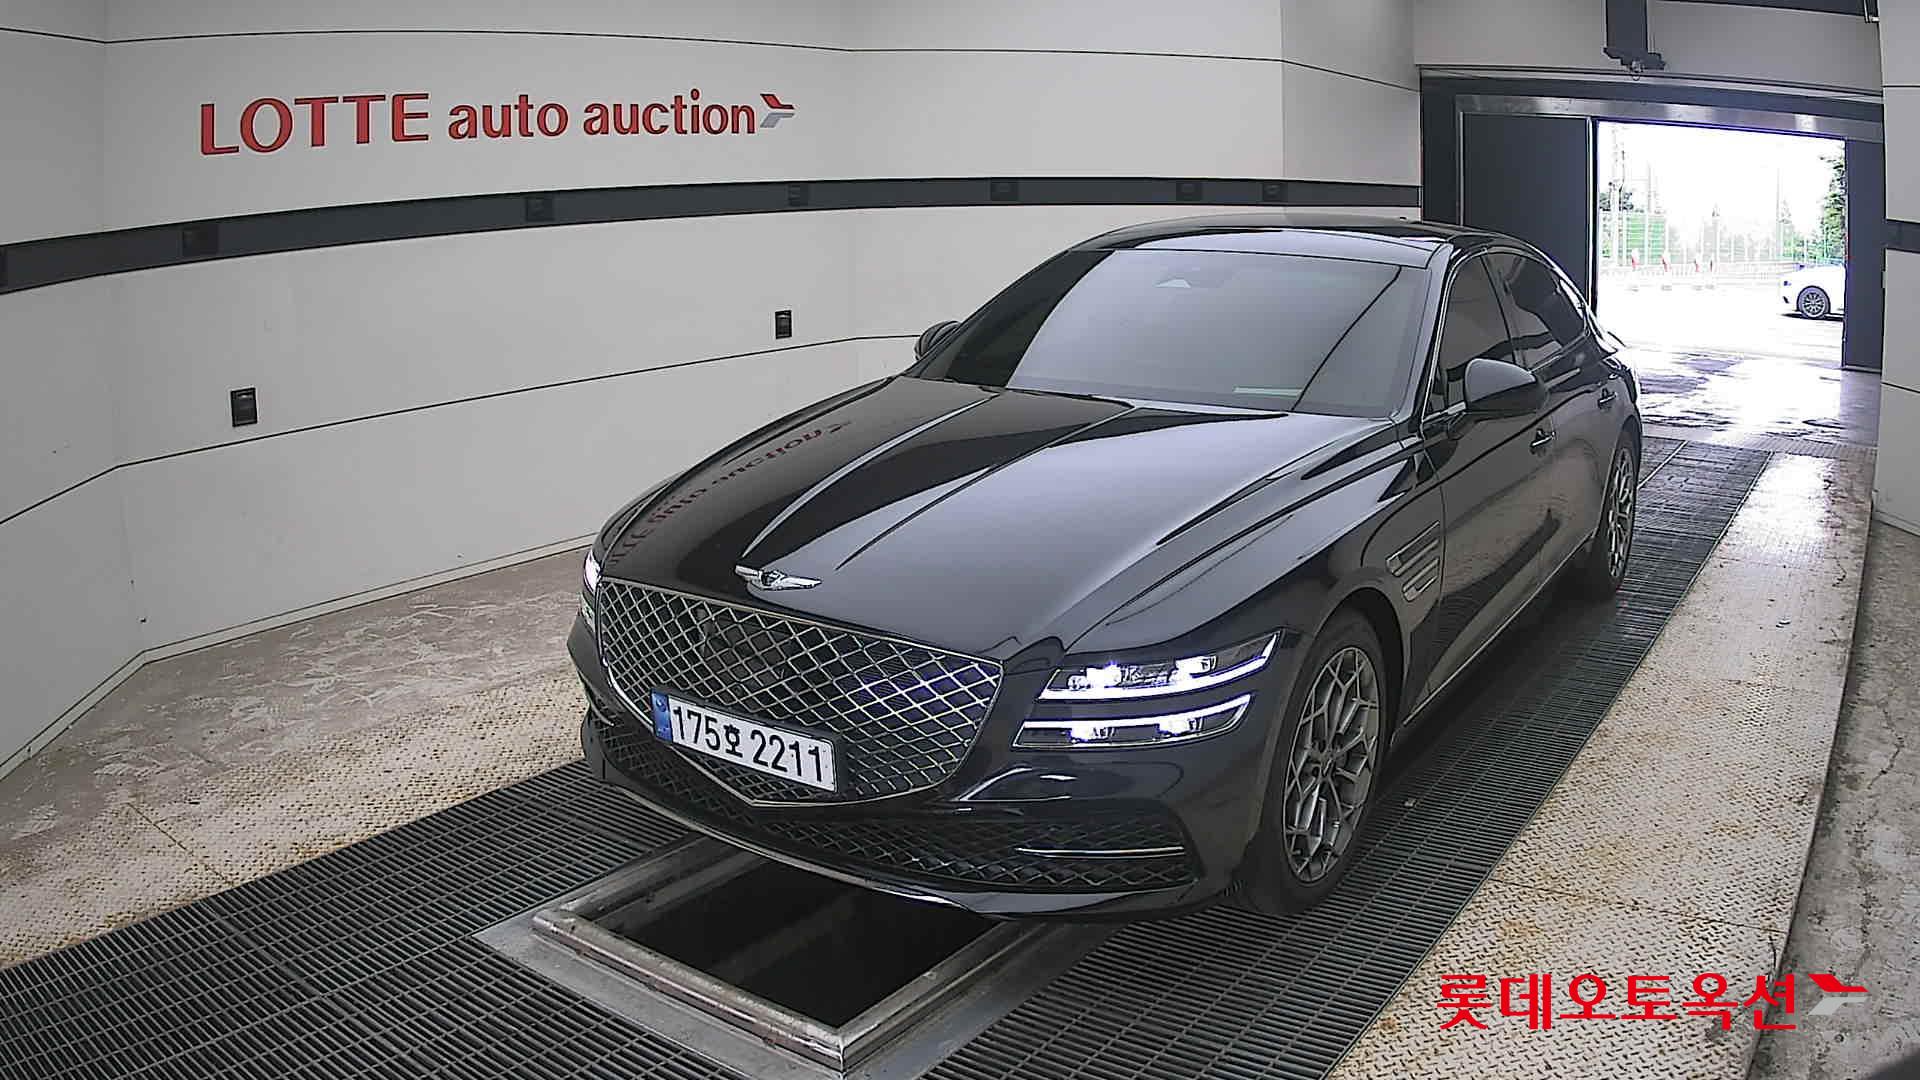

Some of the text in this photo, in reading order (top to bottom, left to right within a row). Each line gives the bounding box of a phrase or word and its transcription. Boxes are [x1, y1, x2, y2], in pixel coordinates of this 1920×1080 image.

[200, 88, 755, 155] LOTTE auto auction
[673, 706, 822, 782] 175호 2211
